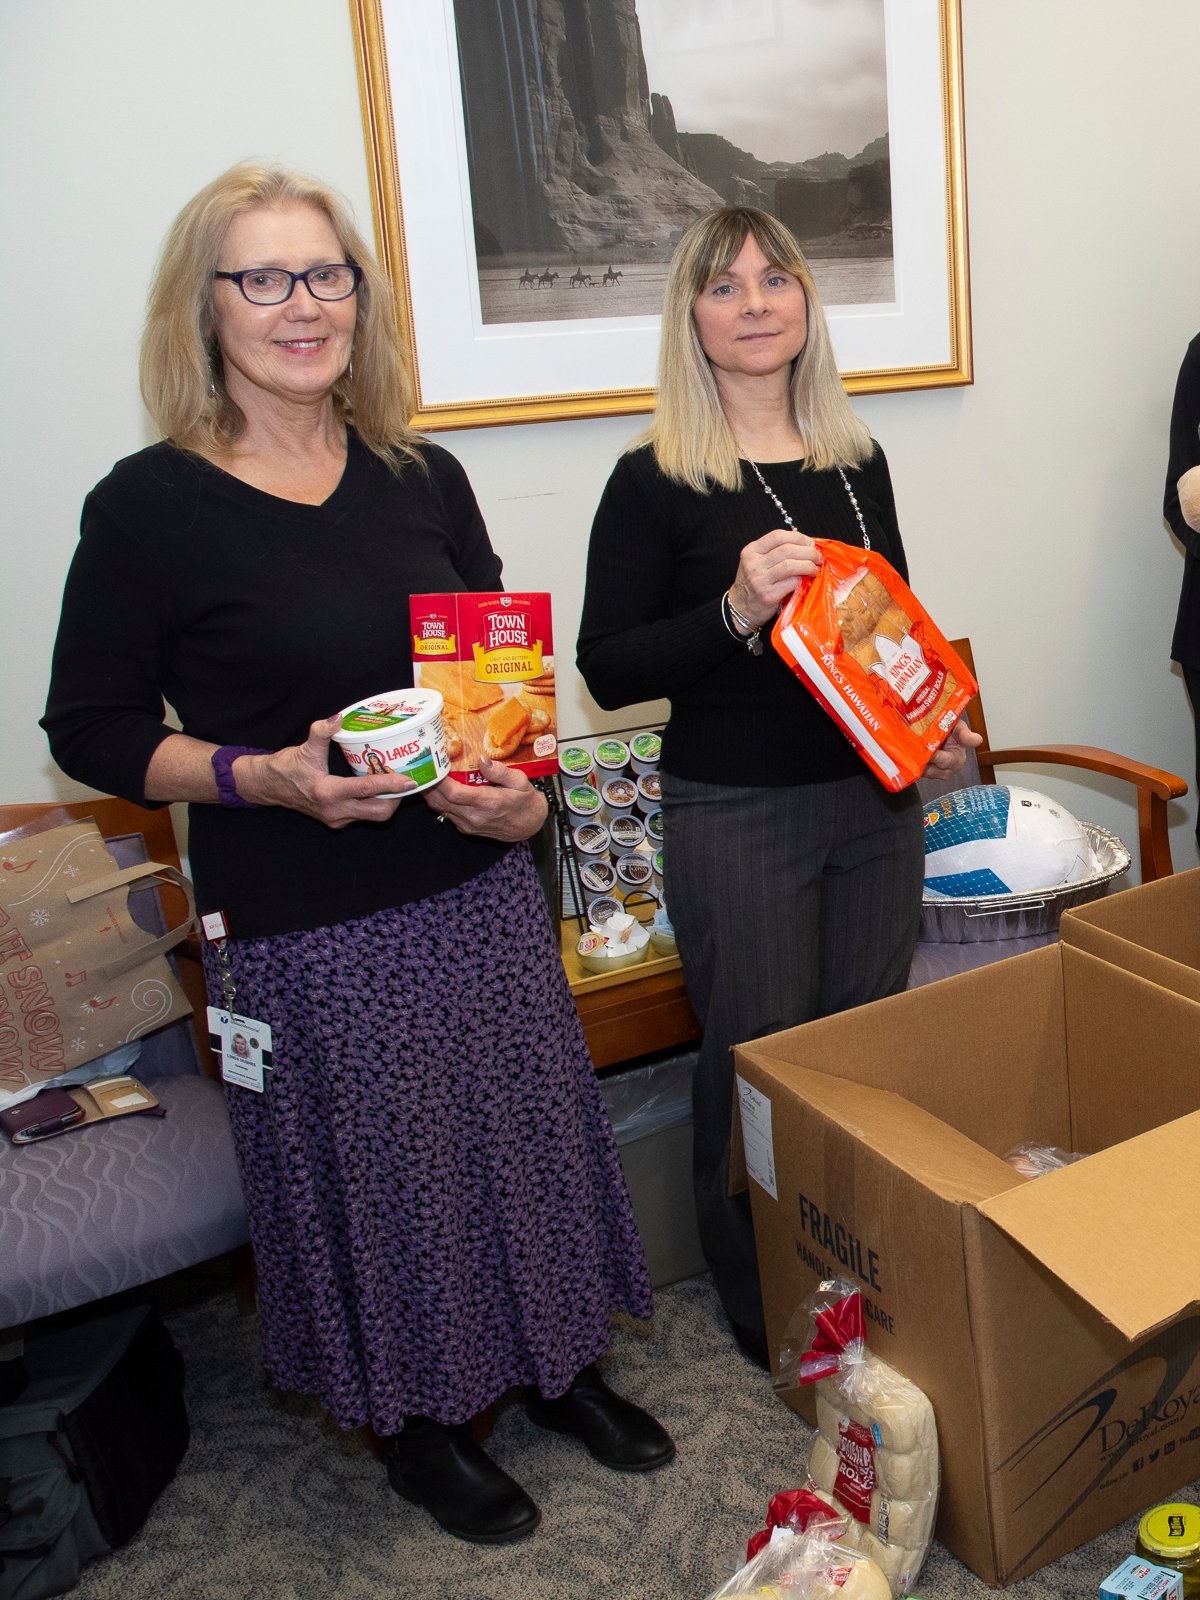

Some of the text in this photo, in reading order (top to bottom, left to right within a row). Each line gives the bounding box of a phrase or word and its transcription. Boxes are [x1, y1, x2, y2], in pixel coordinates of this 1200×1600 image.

[421, 621, 445, 630] TOWN
[488, 613, 525, 631] TOWN
[422, 629, 446, 639] HOUSE
[489, 629, 528, 648] HOUSE
[485, 661, 533, 675] ORIGINAL
[890, 652, 911, 679] KING'S
[895, 656, 923, 692] HAWAIIAN
[819, 653, 845, 685] KING'S
[843, 684, 881, 732] HAWAIIAN
[906, 671, 944, 721] HAWAIIAN SWEET ROLLS
[915, 685, 931, 703] ORIGINAL
[385, 740, 420, 761] LAKES
[926, 741, 936, 752] 16
[7, 965, 67, 1074] SNOW
[799, 1192, 882, 1294] FRAGILE
[795, 1239, 896, 1336] HANDLE CARE
